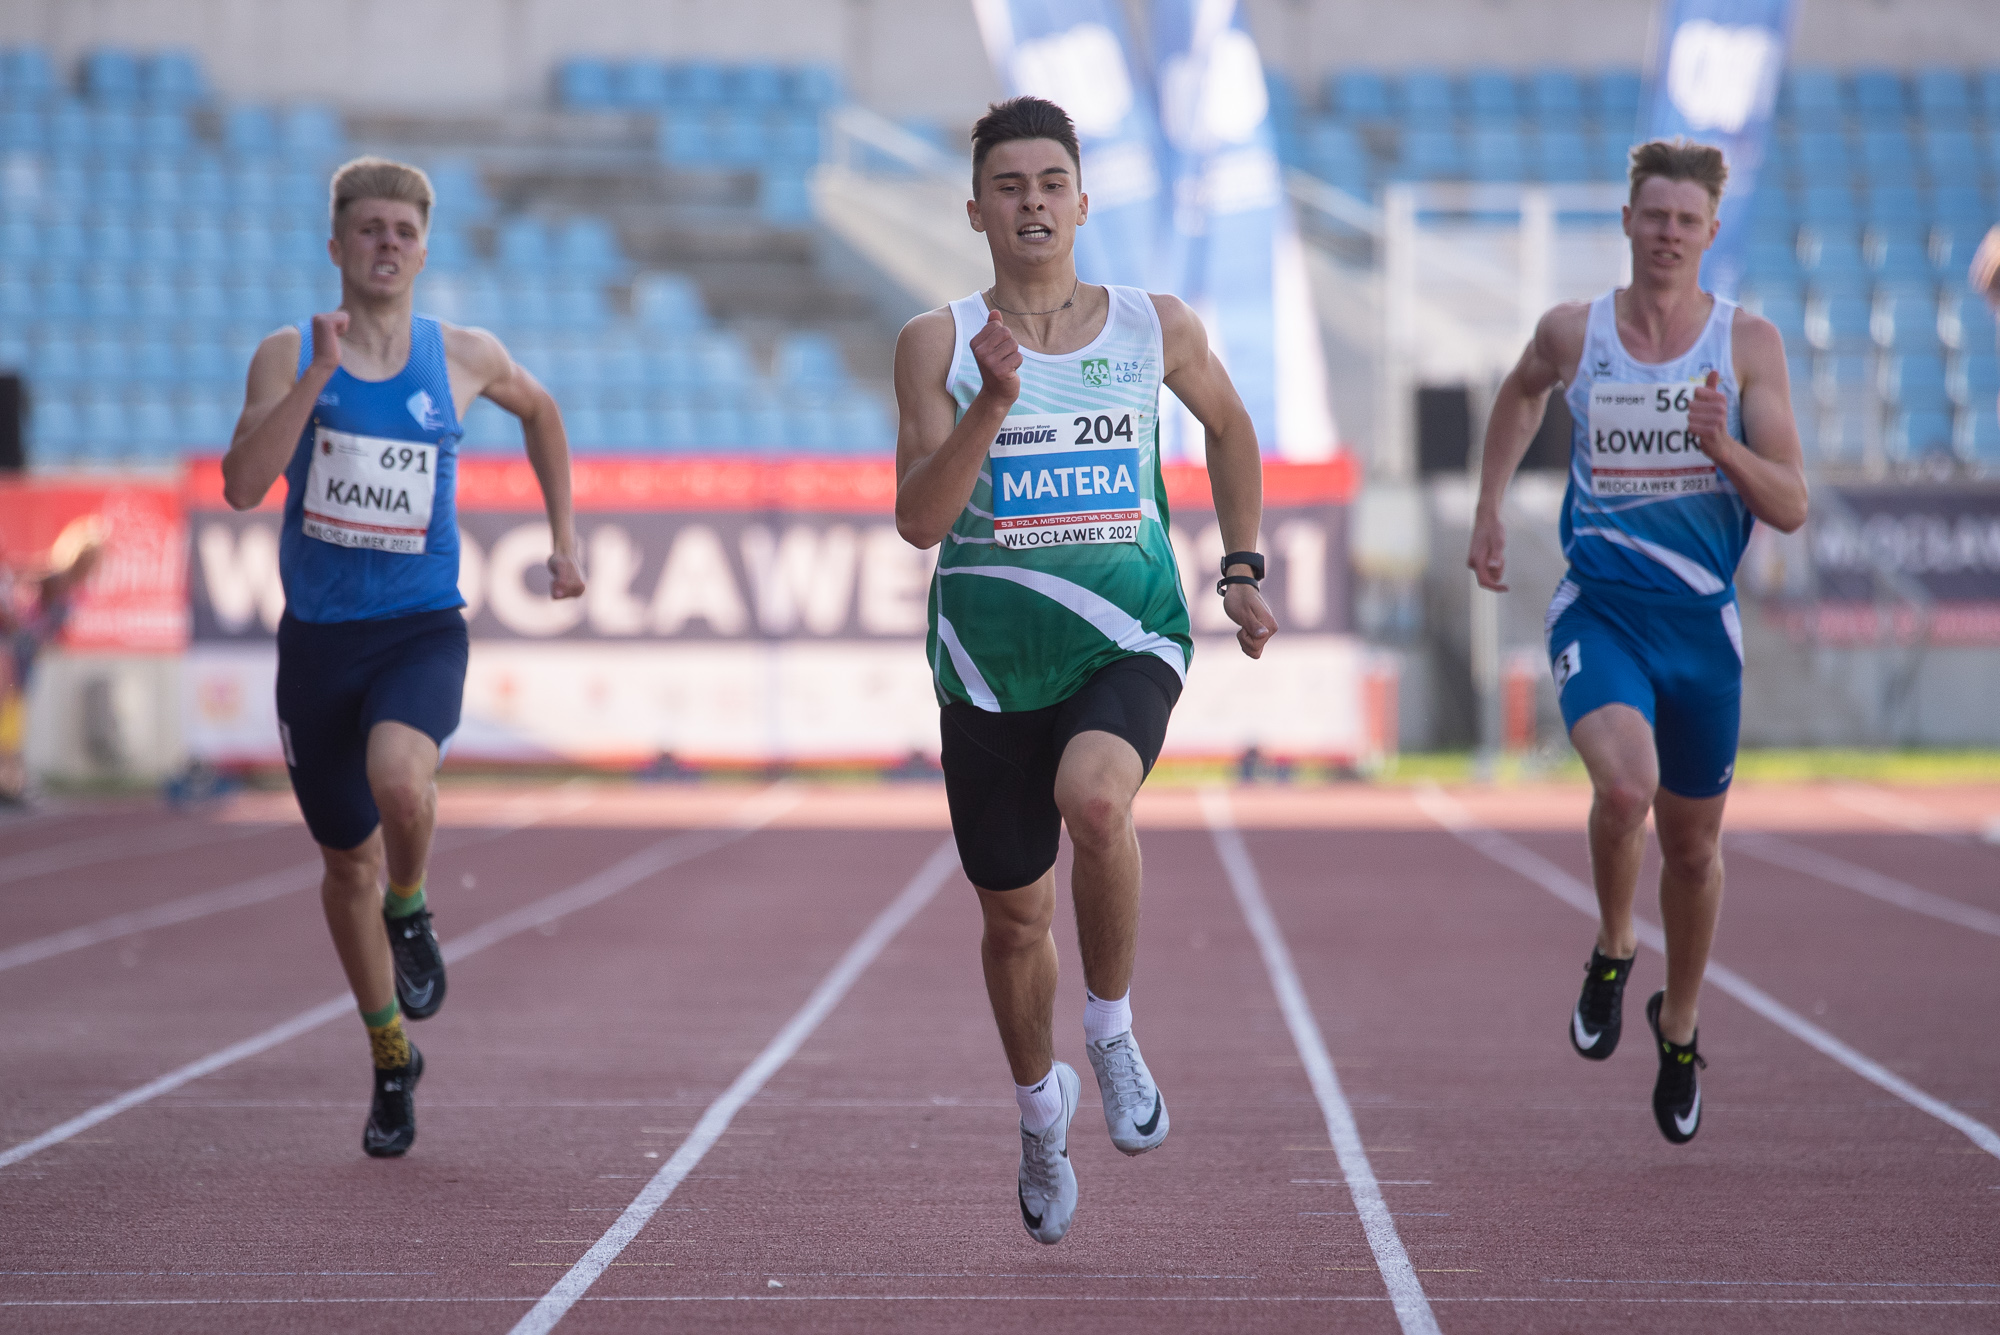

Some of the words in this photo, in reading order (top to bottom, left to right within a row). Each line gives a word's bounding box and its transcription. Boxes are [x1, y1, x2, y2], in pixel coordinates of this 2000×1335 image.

[1115, 361, 1138, 372] AZS
[1655, 388, 1689, 413] 56
[1073, 414, 1133, 445] 204
[1595, 428, 1700, 454] ŁOWICK
[379, 446, 428, 474] 691
[1002, 464, 1136, 502] MATERA
[1681, 478, 1710, 491] 2021
[326, 478, 412, 515] KANIA
[1016, 519, 1039, 527] PZLA
[1039, 515, 1099, 525] MISTRZOSTWA
[1100, 513, 1127, 521] POLSKI
[1003, 526, 1106, 547] WŁOCŁAWEK
[1108, 525, 1138, 540] 2021
[1559, 653, 1571, 687] 3
